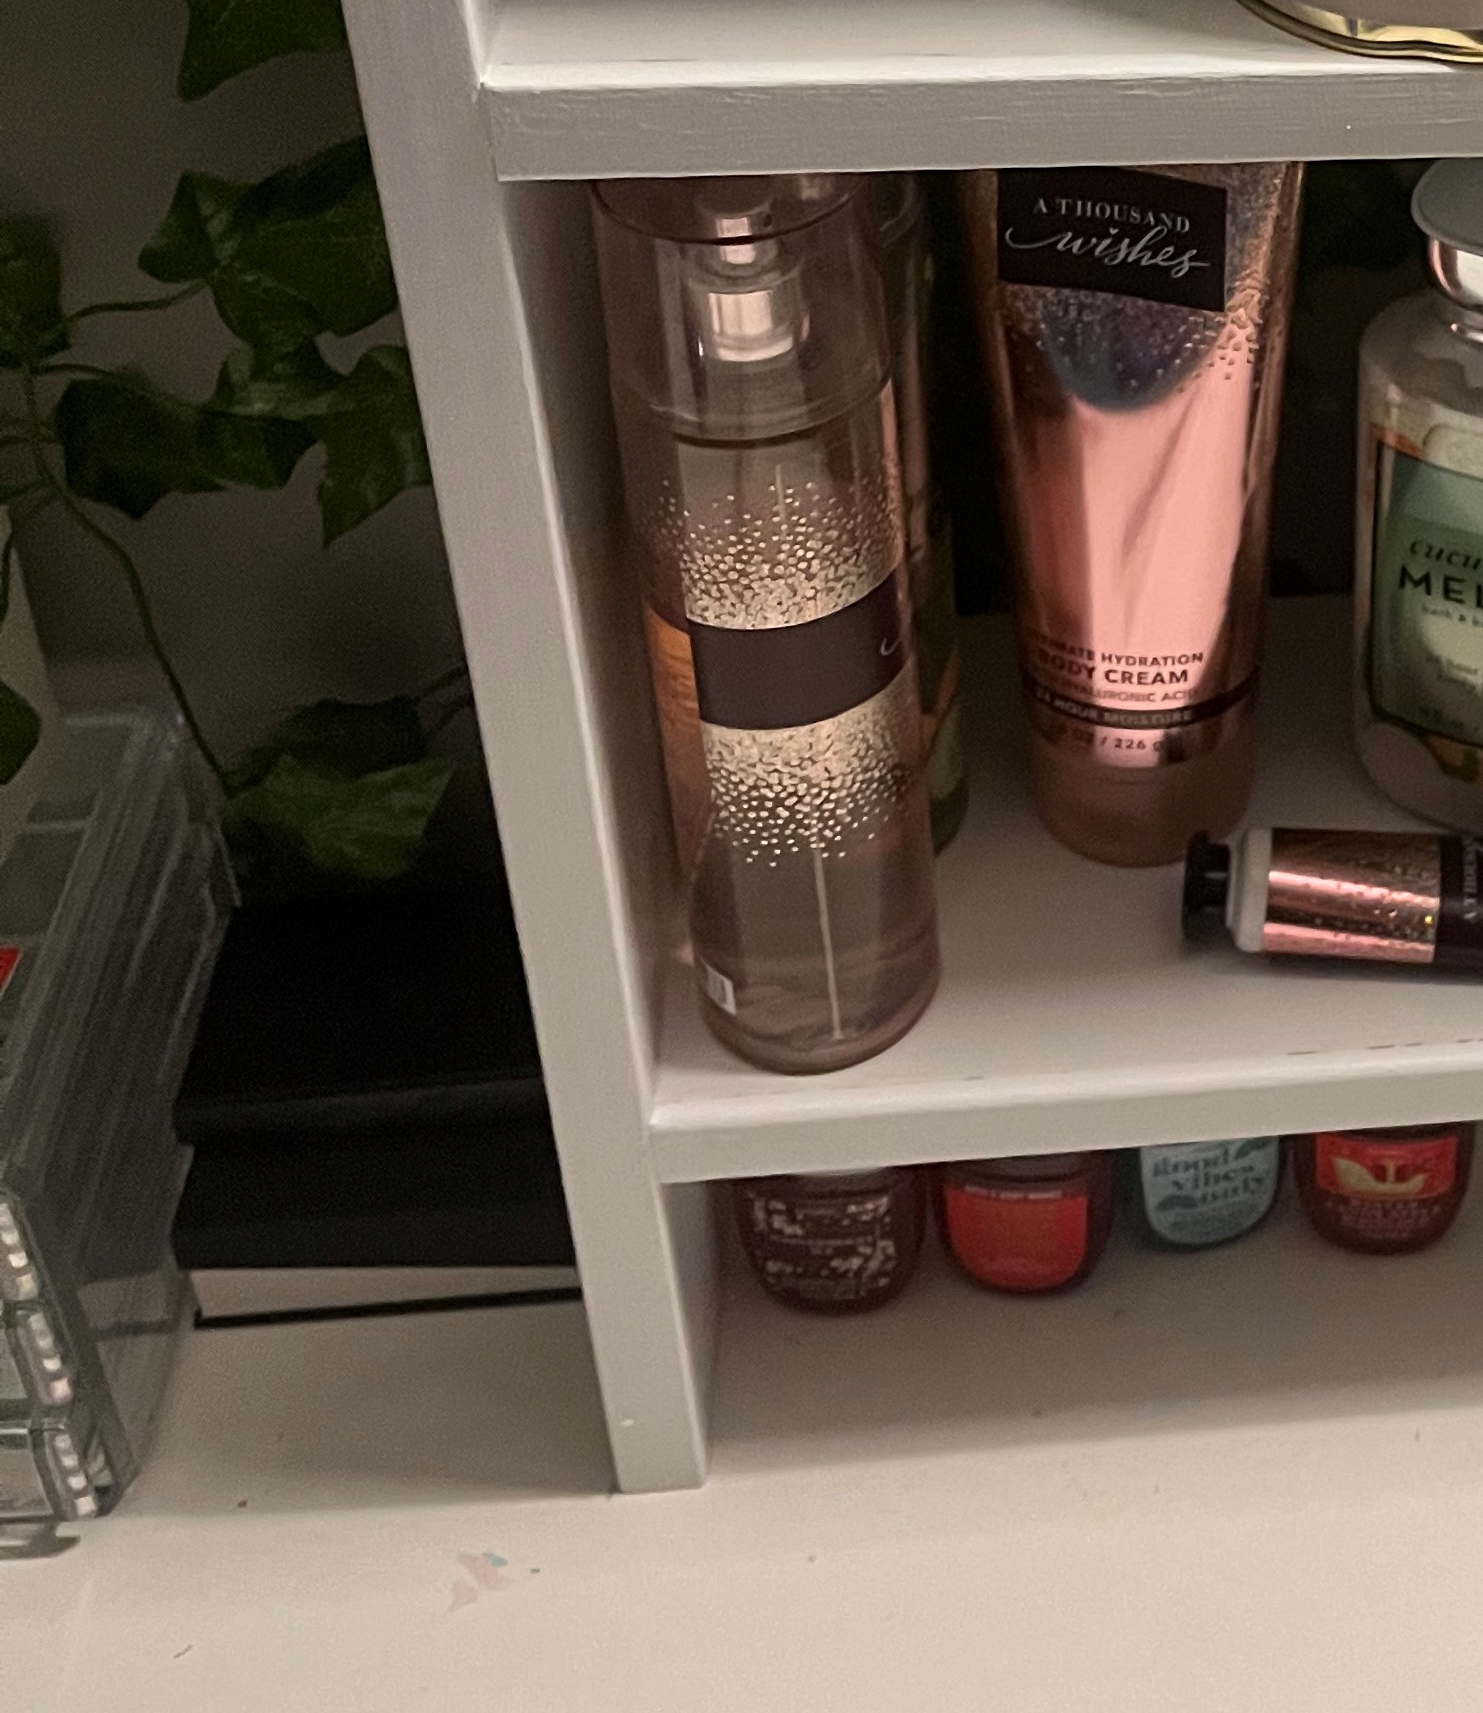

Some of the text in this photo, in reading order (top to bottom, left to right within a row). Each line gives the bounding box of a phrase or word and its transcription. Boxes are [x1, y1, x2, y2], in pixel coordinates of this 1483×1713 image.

[1032, 197, 1191, 234] A THOUSAND
[1004, 224, 1211, 279] wishes
[1100, 651, 1205, 668] HYDRATION
[1103, 668, 1190, 686] CREAM
[1113, 737, 1147, 751] 226
